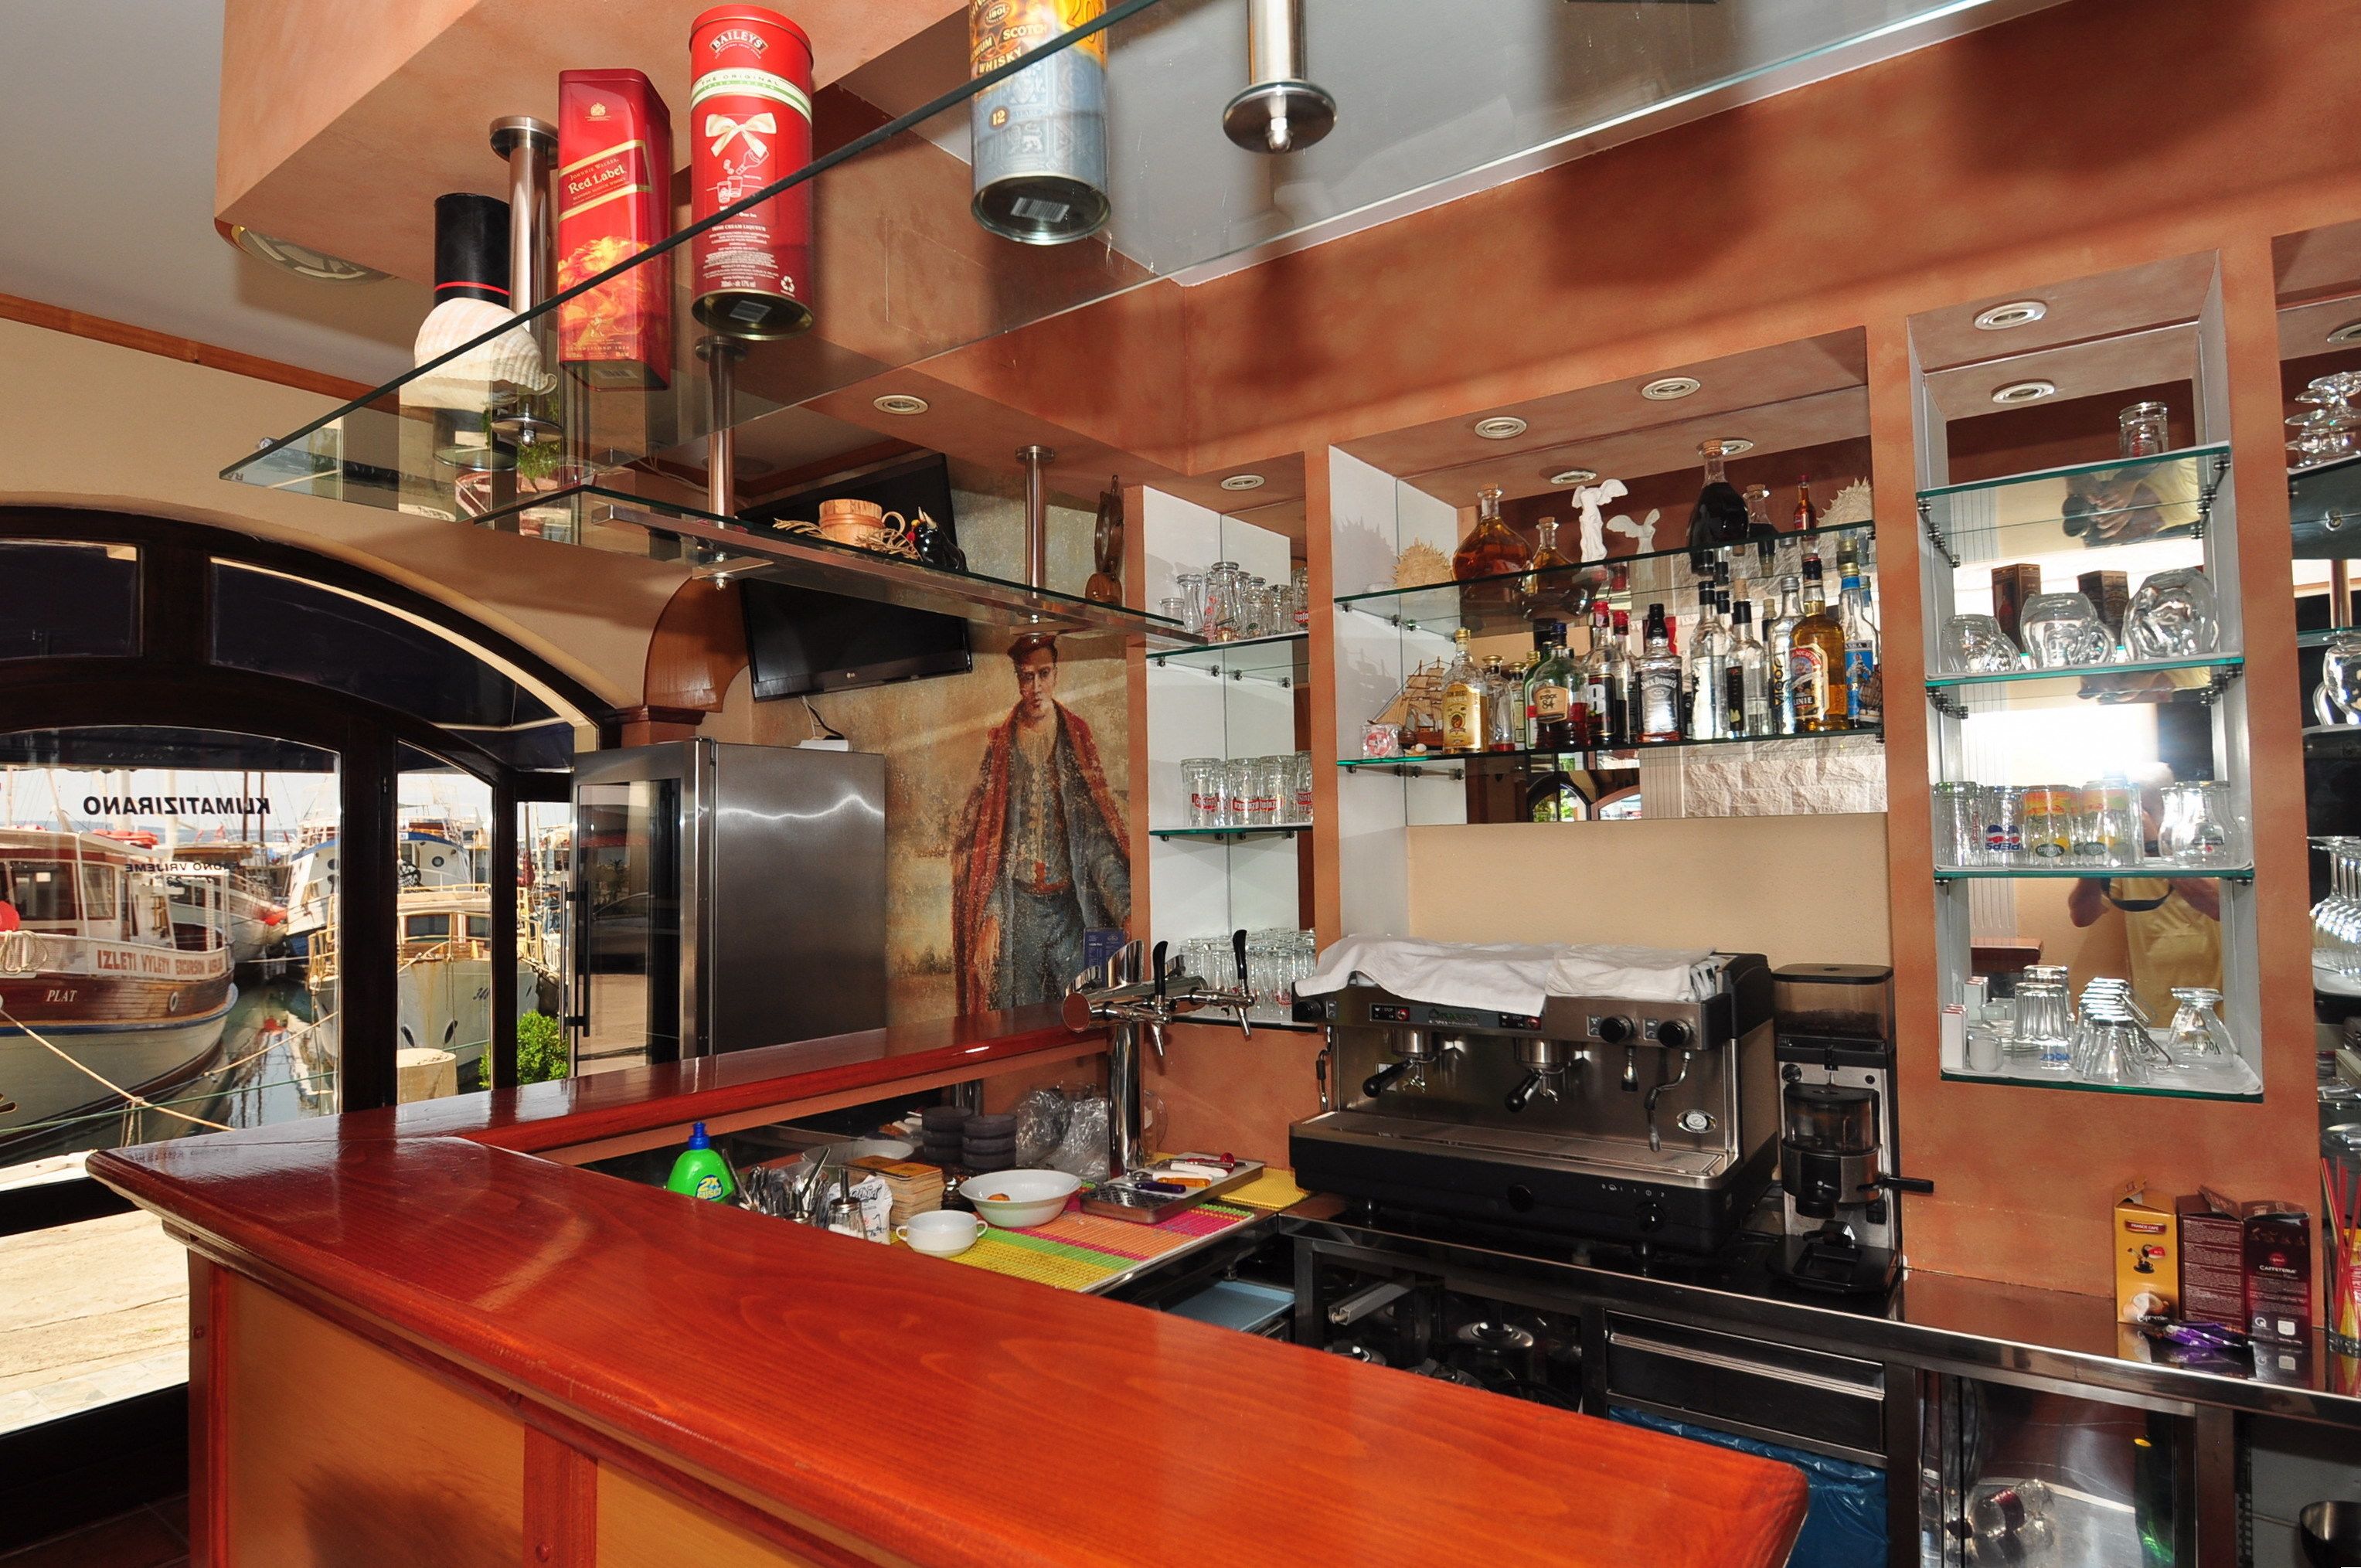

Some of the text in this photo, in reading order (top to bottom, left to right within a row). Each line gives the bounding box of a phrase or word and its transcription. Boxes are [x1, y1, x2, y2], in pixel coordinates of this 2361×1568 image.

[712, 29, 764, 51] BAILEYS
[1002, 24, 1046, 41] SCOTCH
[978, 47, 1022, 73] WHISKY
[701, 73, 779, 86] THE ORIGINAL
[992, 110, 1005, 126] 12
[568, 175, 593, 195] Red
[593, 164, 627, 185] Label
[1641, 679, 1655, 690] JACK
[97, 950, 138, 971] IZLETI
[46, 989, 77, 1002] PLAT
[699, 1177, 718, 1191] 2X
